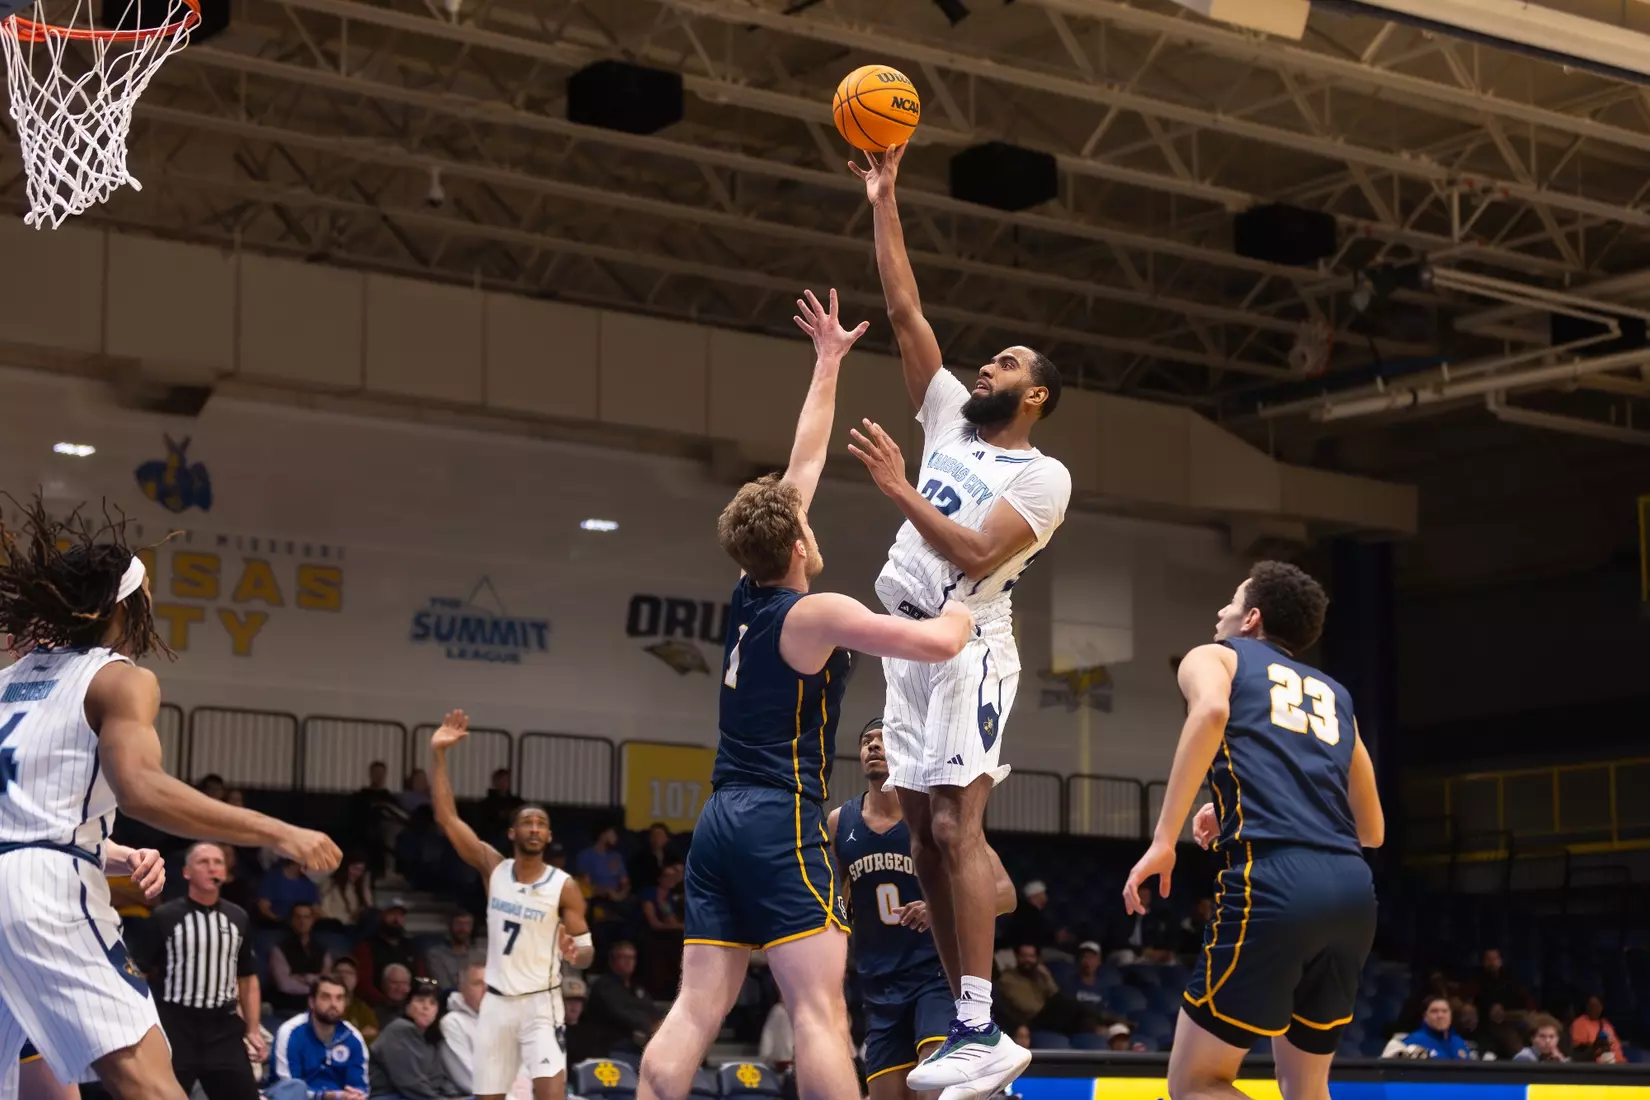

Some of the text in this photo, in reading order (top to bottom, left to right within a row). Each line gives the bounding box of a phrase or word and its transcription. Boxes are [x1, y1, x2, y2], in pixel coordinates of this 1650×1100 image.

[963, 473, 994, 506] CITY
[410, 610, 550, 651] SUMMIT
[627, 594, 731, 646] ORU
[724, 623, 749, 690] 1
[1267, 662, 1340, 747] 23
[650, 779, 702, 819] 107
[876, 883, 901, 926] 0
[502, 920, 523, 956] 7
